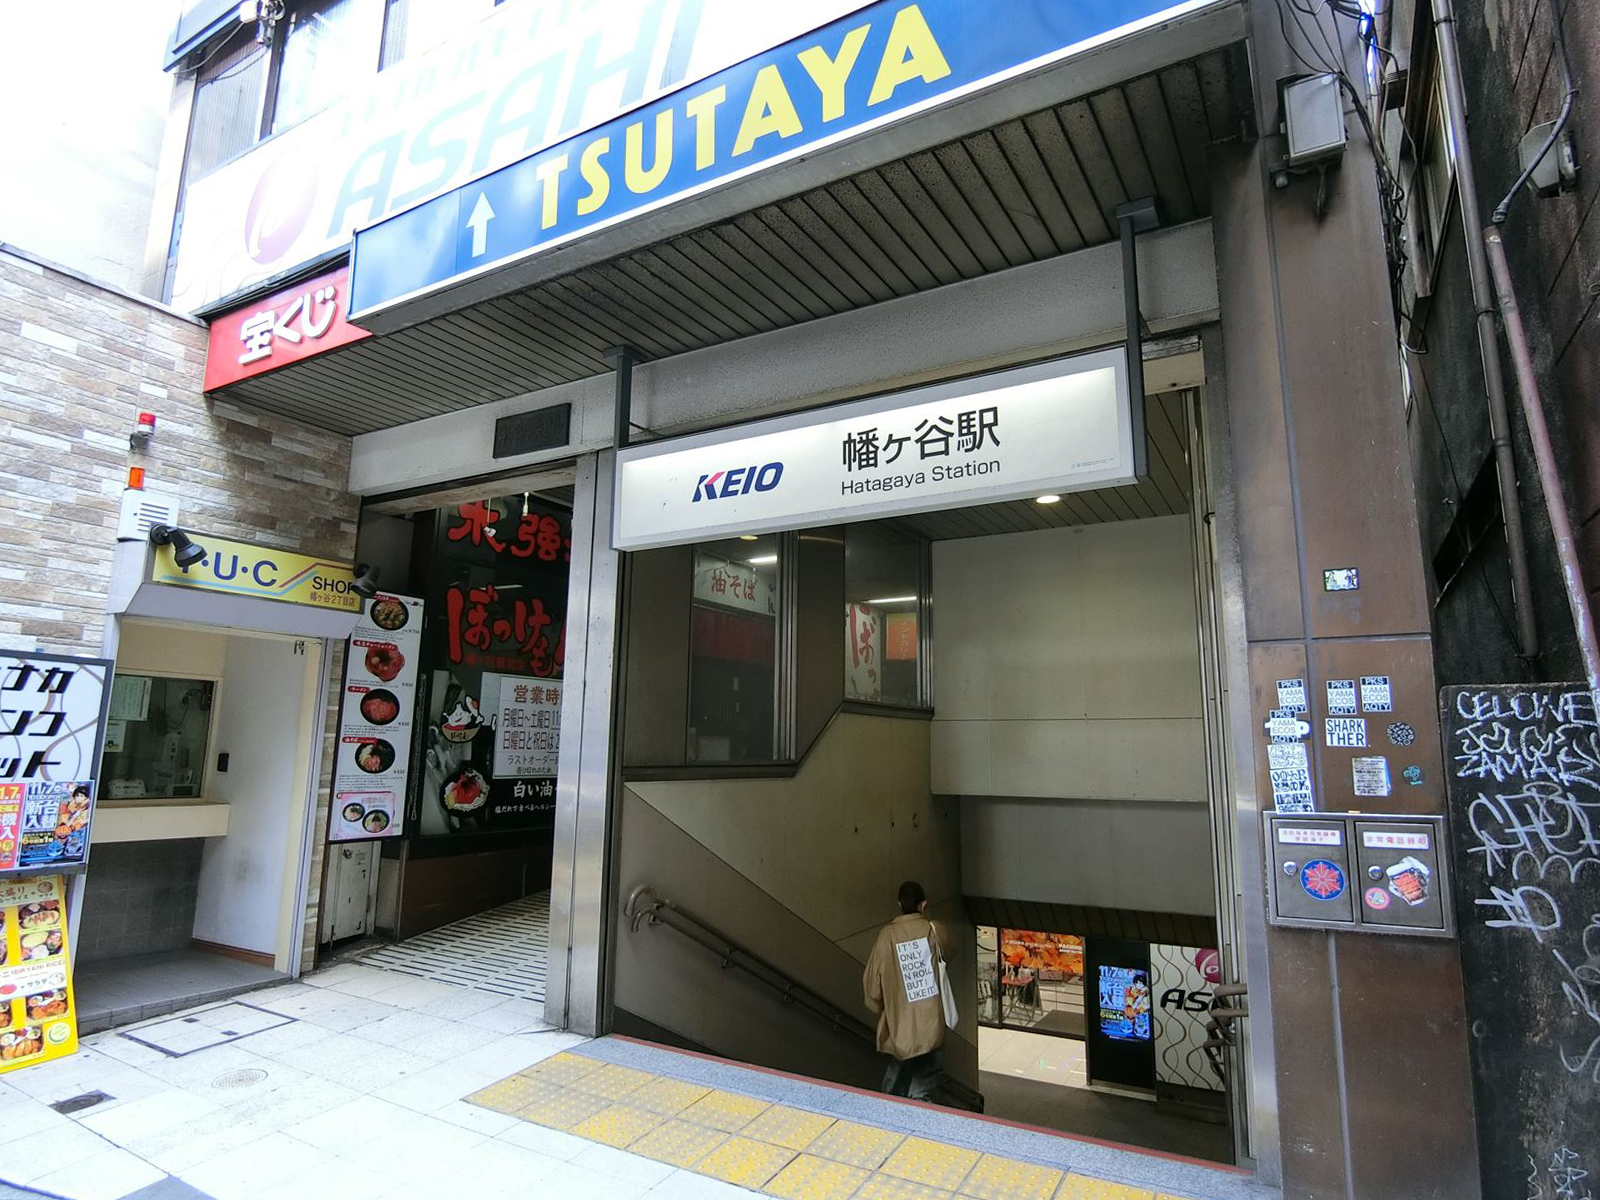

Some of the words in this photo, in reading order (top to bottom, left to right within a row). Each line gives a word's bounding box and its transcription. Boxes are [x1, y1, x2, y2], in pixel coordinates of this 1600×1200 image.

[536, 3, 952, 230] TSUTAYA
[238, 285, 337, 365] 宝くじ
[841, 406, 1001, 472] 幡ヶ谷駅
[692, 461, 784, 502] KEIO
[841, 470, 925, 495] Hatagaya
[932, 459, 1001, 482] Station
[711, 569, 759, 601] 油そば
[447, 585, 568, 677] ぼっけも
[1281, 680, 1299, 689] PKS
[1331, 681, 1350, 689] PKS
[1366, 677, 1384, 685] PKS
[514, 684, 562, 706] 営業時
[1278, 689, 1304, 698] YAMA
[1328, 690, 1354, 698] YAMA
[1362, 686, 1389, 694] YAMA
[1280, 696, 1304, 704] ECOS
[1329, 697, 1355, 705] ECOS
[1363, 694, 1389, 702] ECOS
[1274, 710, 1292, 718] PKS
[1271, 719, 1297, 727] YAMA
[1326, 719, 1364, 733] SHARK
[1272, 726, 1297, 734] ECOS
[1327, 733, 1365, 746] THER
[513, 780, 558, 799] 白い油
[898, 941, 919, 953] IT'S
[899, 950, 922, 962] ONLY
[901, 959, 926, 972] ROCK
[904, 972, 911, 981] N
[913, 968, 933, 979] ROLL
[906, 979, 924, 991] BUT
[908, 988, 927, 1001] LIKE
[1161, 988, 1215, 1011] AS
